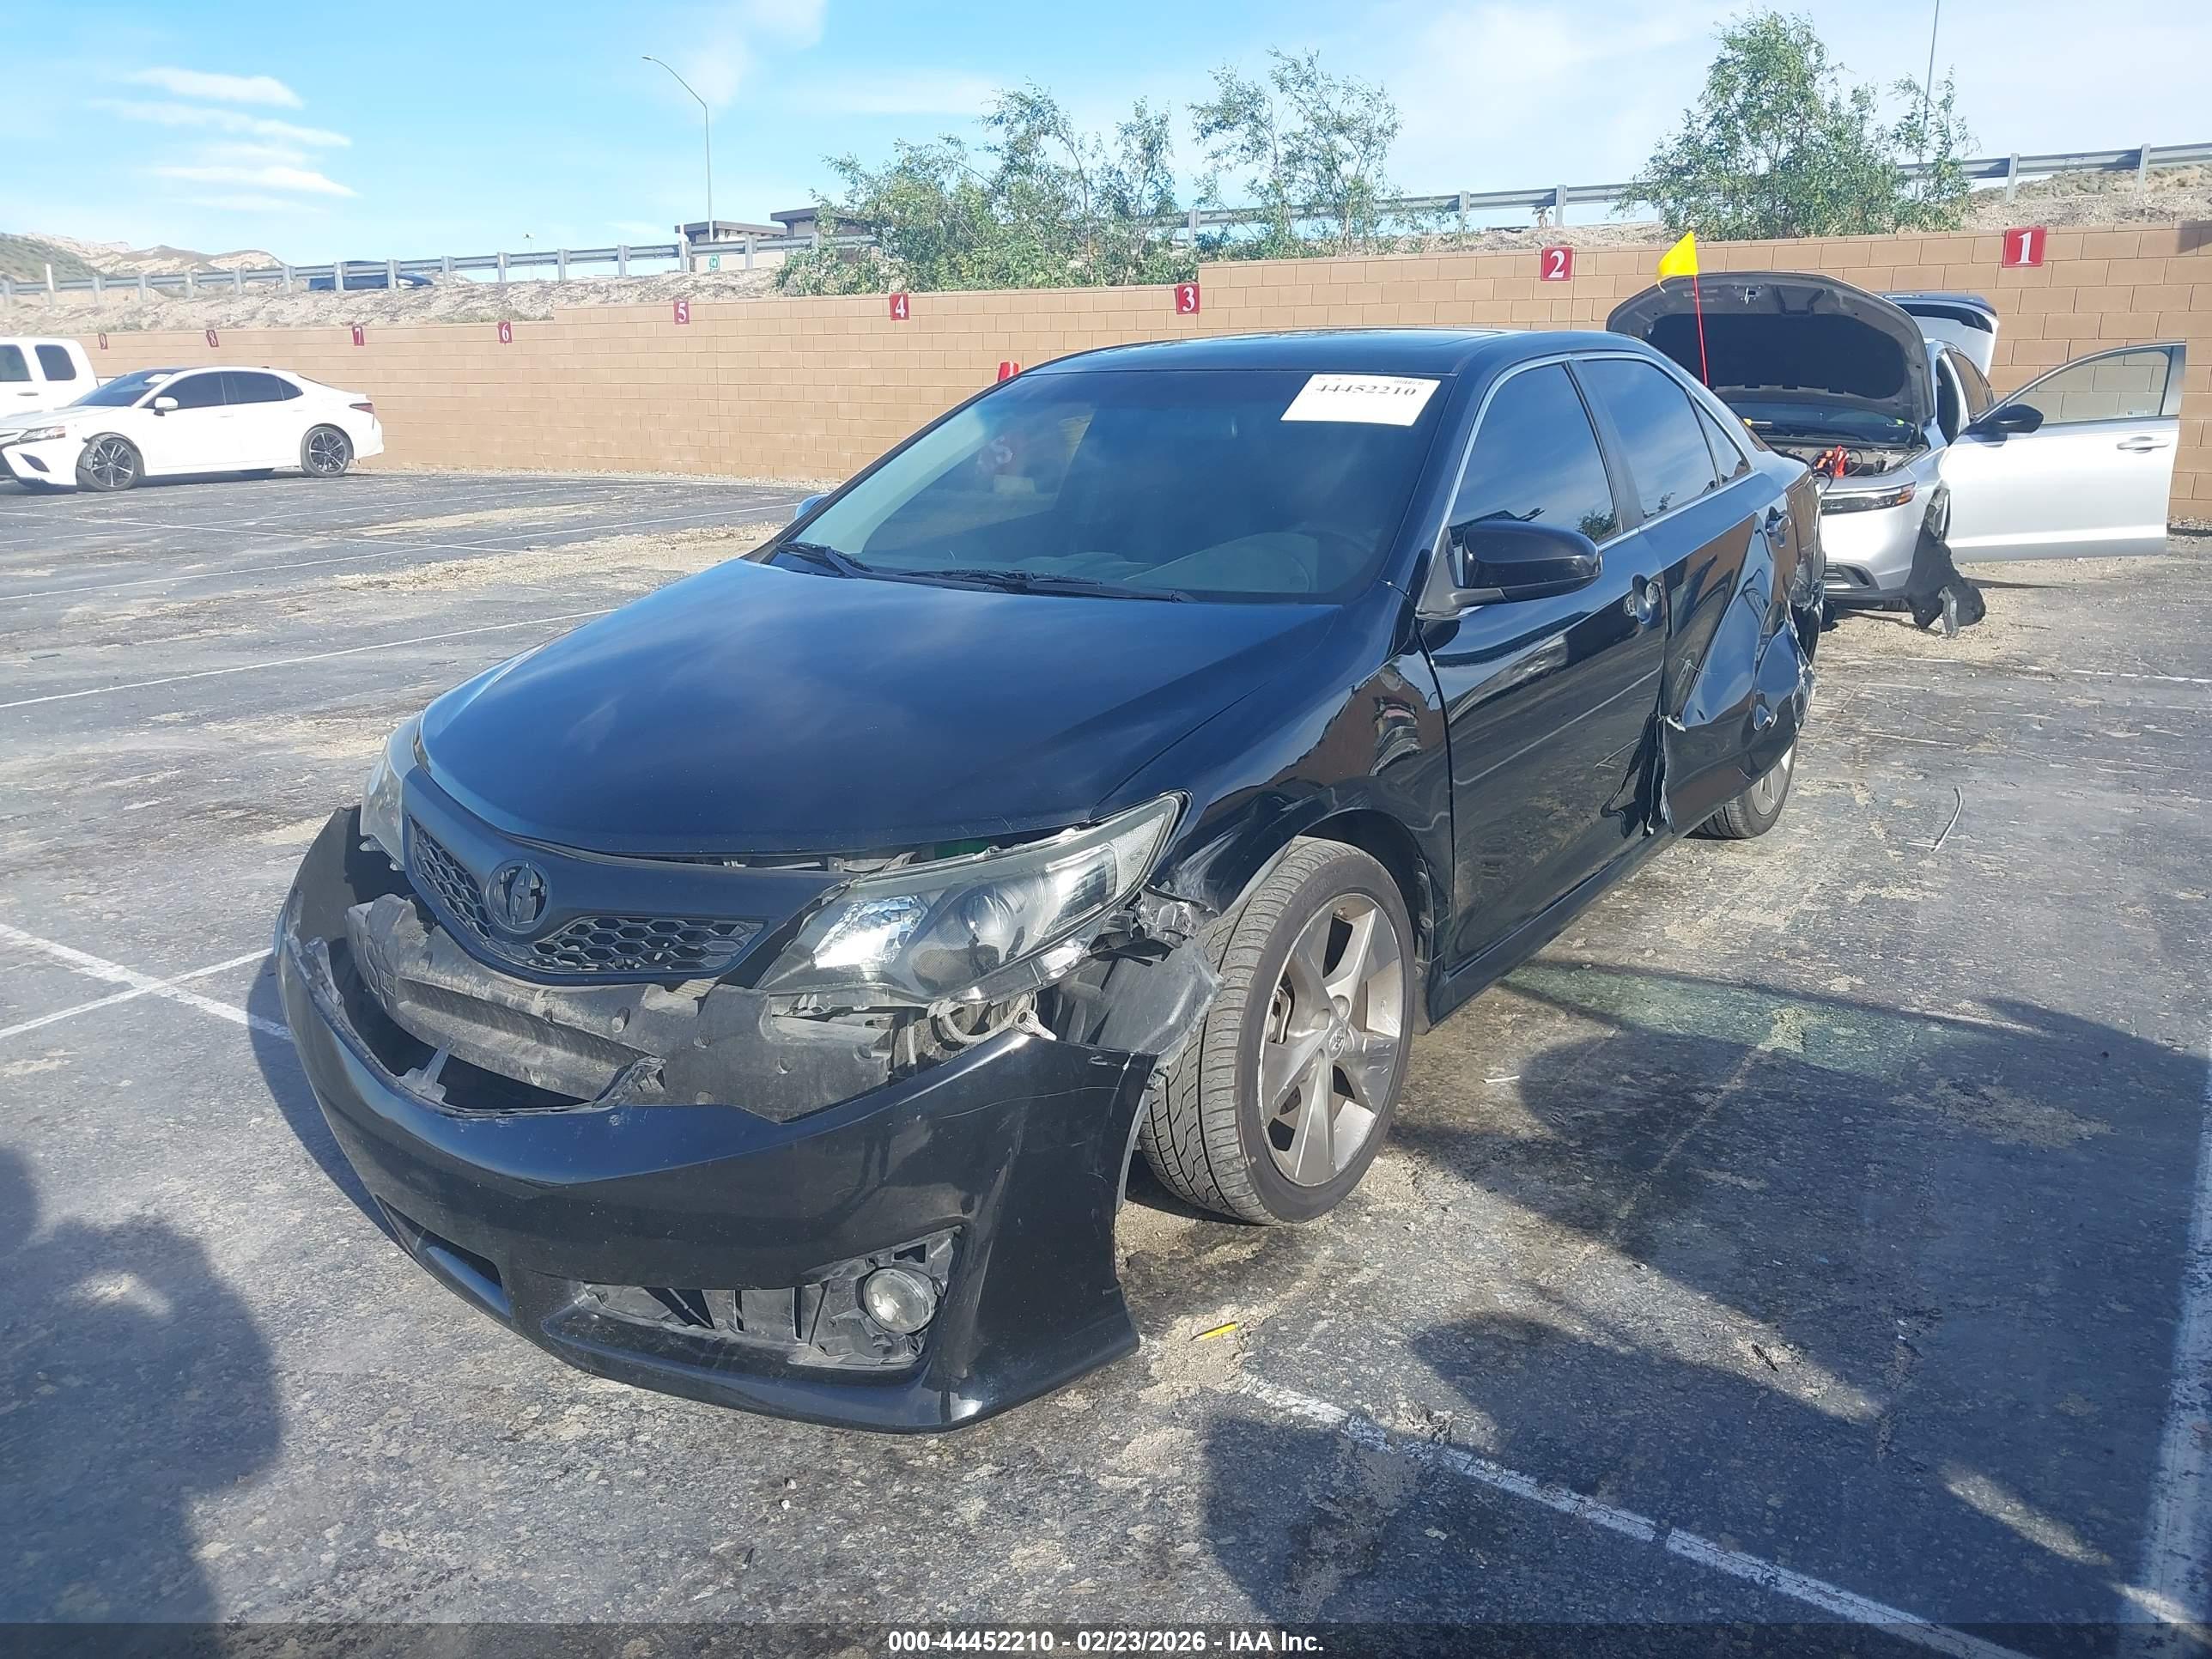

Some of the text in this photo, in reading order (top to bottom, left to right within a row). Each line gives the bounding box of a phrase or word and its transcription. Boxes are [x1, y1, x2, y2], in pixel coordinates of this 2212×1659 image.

[2014, 231, 2033, 264] 1
[1548, 250, 1565, 278] 2
[895, 295, 906, 318] 4
[1182, 286, 1195, 312] 3
[677, 302, 687, 322] 5
[99, 333, 106, 349] 9
[209, 330, 217, 347] 8
[354, 327, 362, 344] 7
[501, 323, 509, 342] 6
[1316, 384, 1417, 396] 44452210
